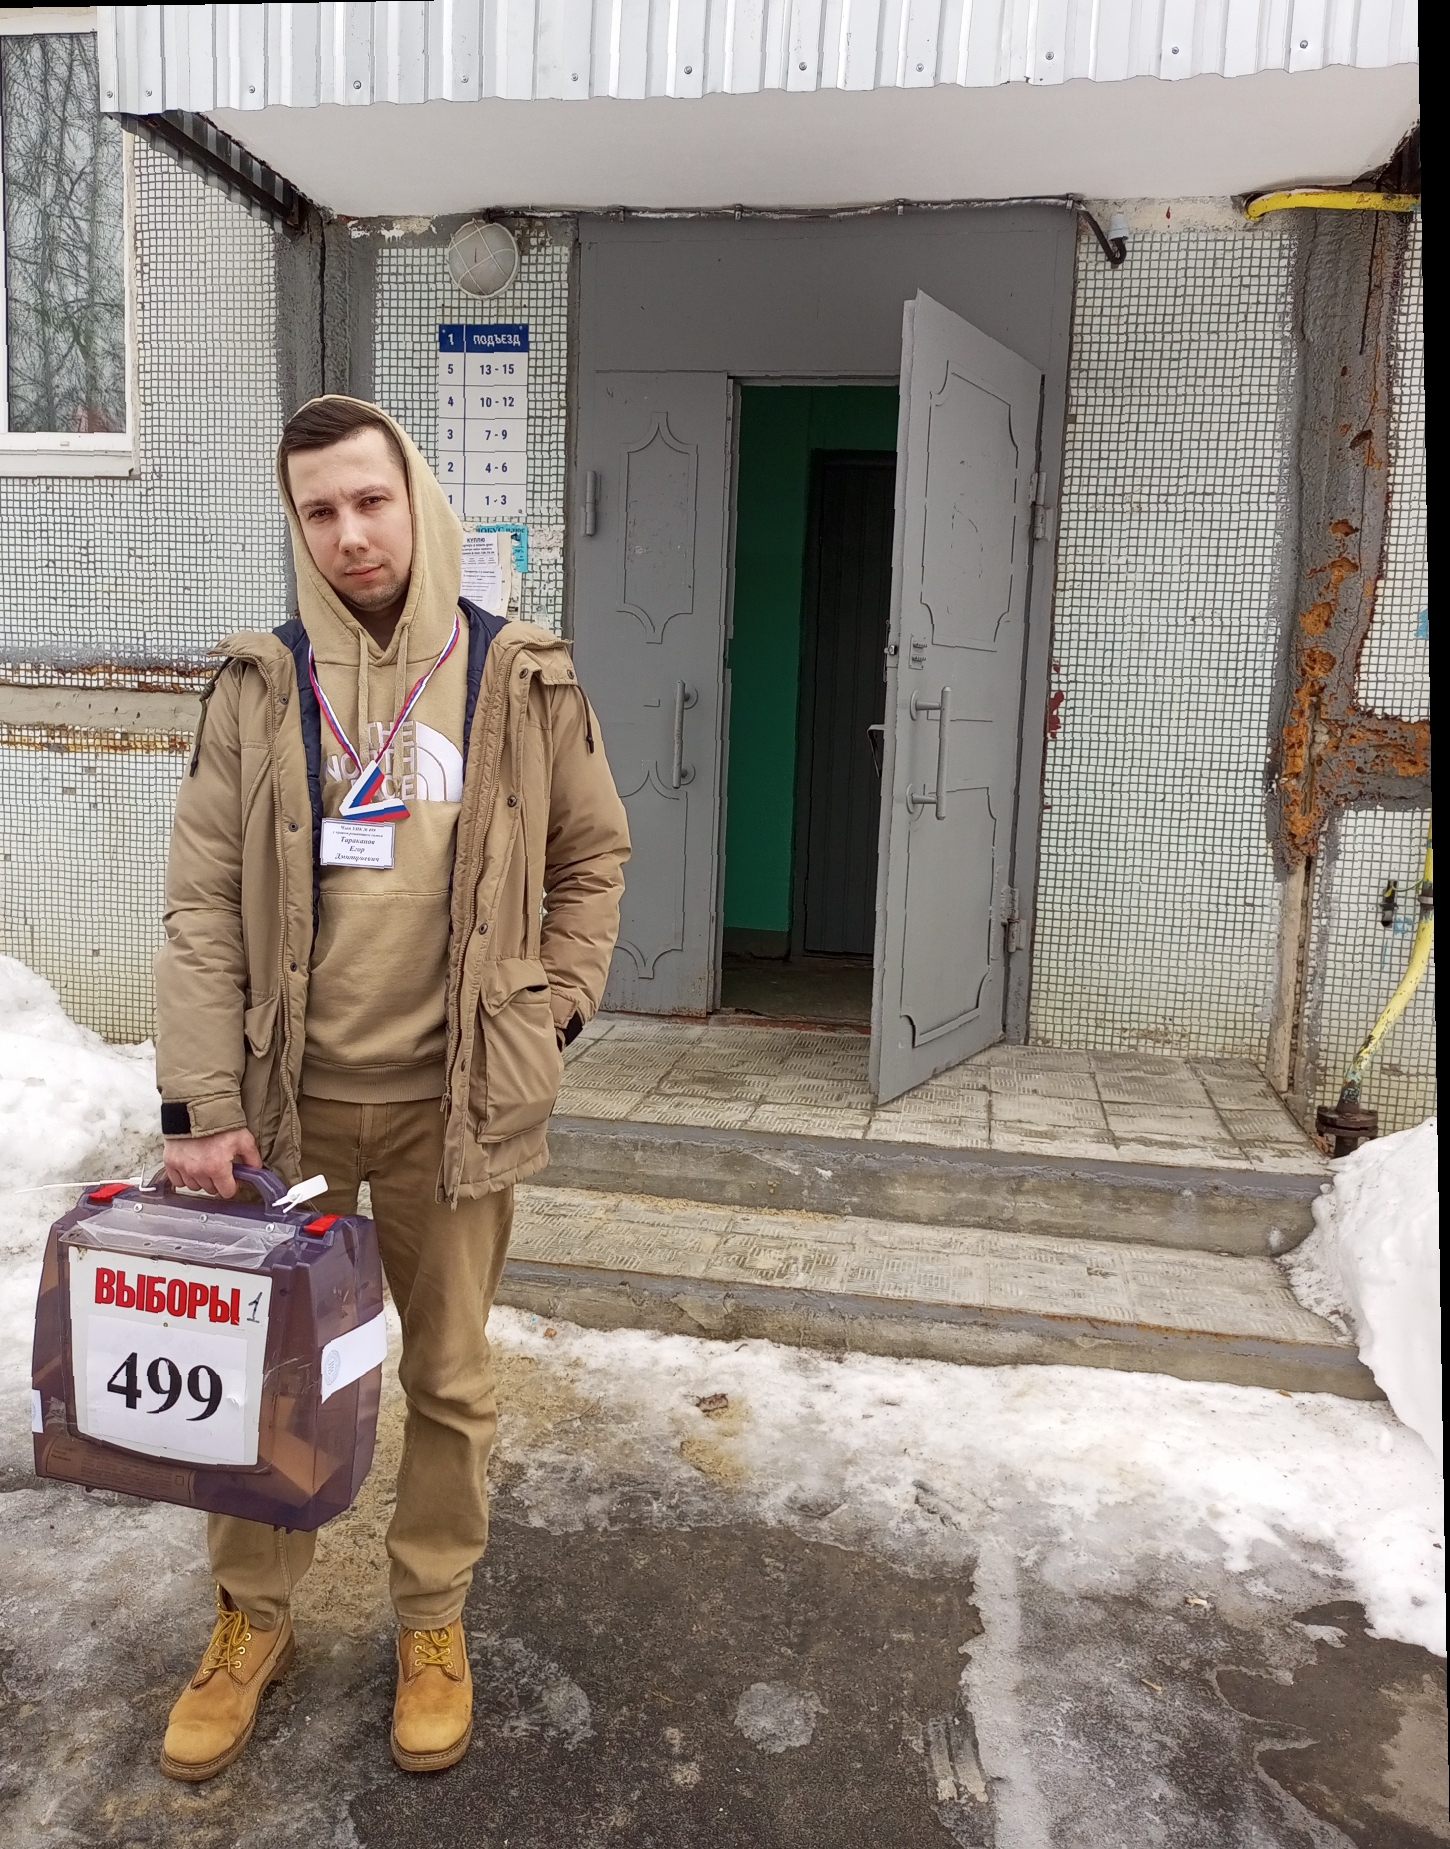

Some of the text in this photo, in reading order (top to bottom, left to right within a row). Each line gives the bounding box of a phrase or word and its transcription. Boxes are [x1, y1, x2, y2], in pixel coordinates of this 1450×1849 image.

[448, 333, 521, 347] 1 ПОДЪЕЗД
[447, 363, 454, 375] 5
[480, 364, 492, 375] 13
[502, 363, 515, 375] 15
[447, 396, 454, 407] 4
[480, 397, 492, 408] 10
[502, 396, 515, 407] 12
[447, 429, 454, 440] 3
[485, 430, 492, 441] 7
[501, 429, 508, 440] 9
[447, 461, 454, 473] 2
[485, 463, 492, 474] 4
[501, 462, 508, 473] 6
[448, 494, 453, 505] 1
[485, 495, 490, 506] 1
[500, 494, 507, 505] 3
[94, 1267, 241, 1327] ВЫБОРЫ
[246, 1291, 263, 1324] 1
[106, 1352, 223, 1422] 499
